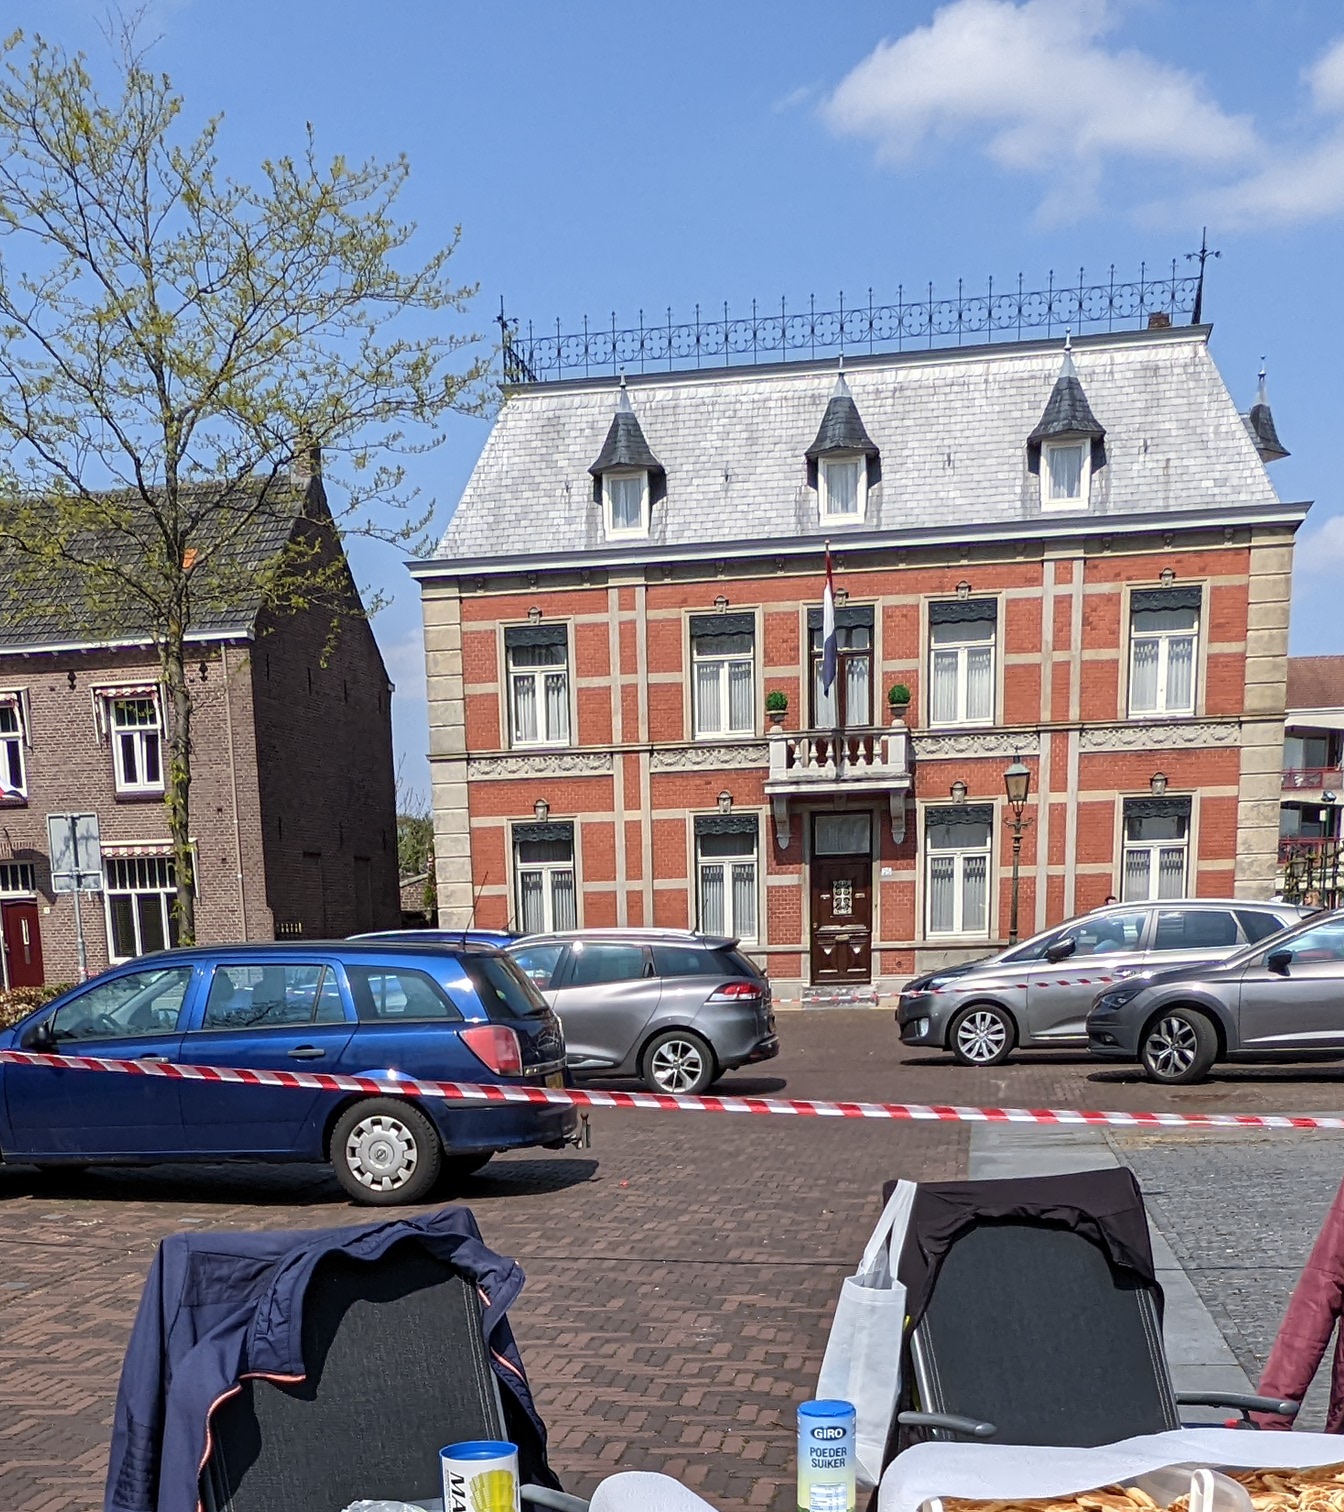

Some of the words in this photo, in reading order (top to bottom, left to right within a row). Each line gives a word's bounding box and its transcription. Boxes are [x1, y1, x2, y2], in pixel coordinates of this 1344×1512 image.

[814, 1428, 844, 1440] GIRO
[810, 1447, 847, 1457] POEDER
[812, 1458, 846, 1468] SUIKER
